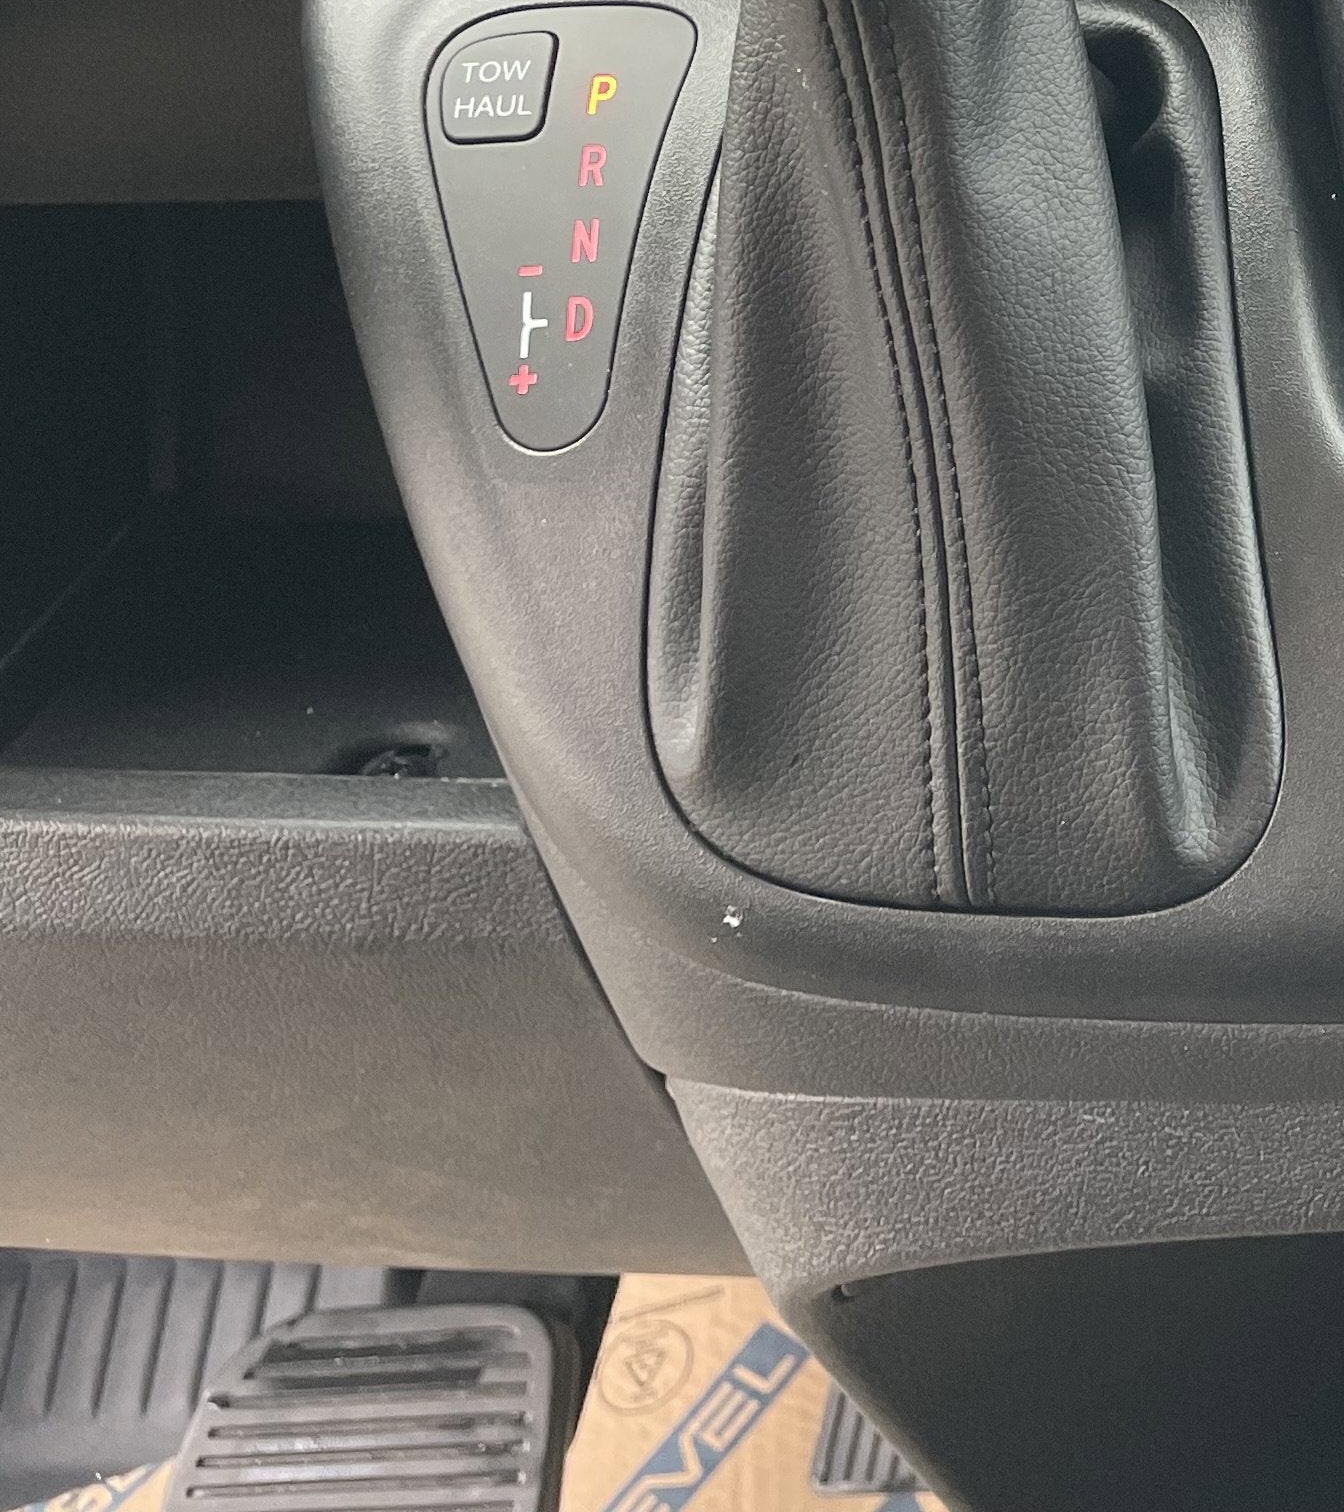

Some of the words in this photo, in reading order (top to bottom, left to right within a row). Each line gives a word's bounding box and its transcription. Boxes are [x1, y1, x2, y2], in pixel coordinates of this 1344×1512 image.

[462, 60, 531, 84] TOW
[453, 95, 532, 119] HAUL
[586, 73, 618, 116] P
[578, 143, 608, 187] R
[571, 218, 600, 263] N
[564, 295, 595, 342] D
